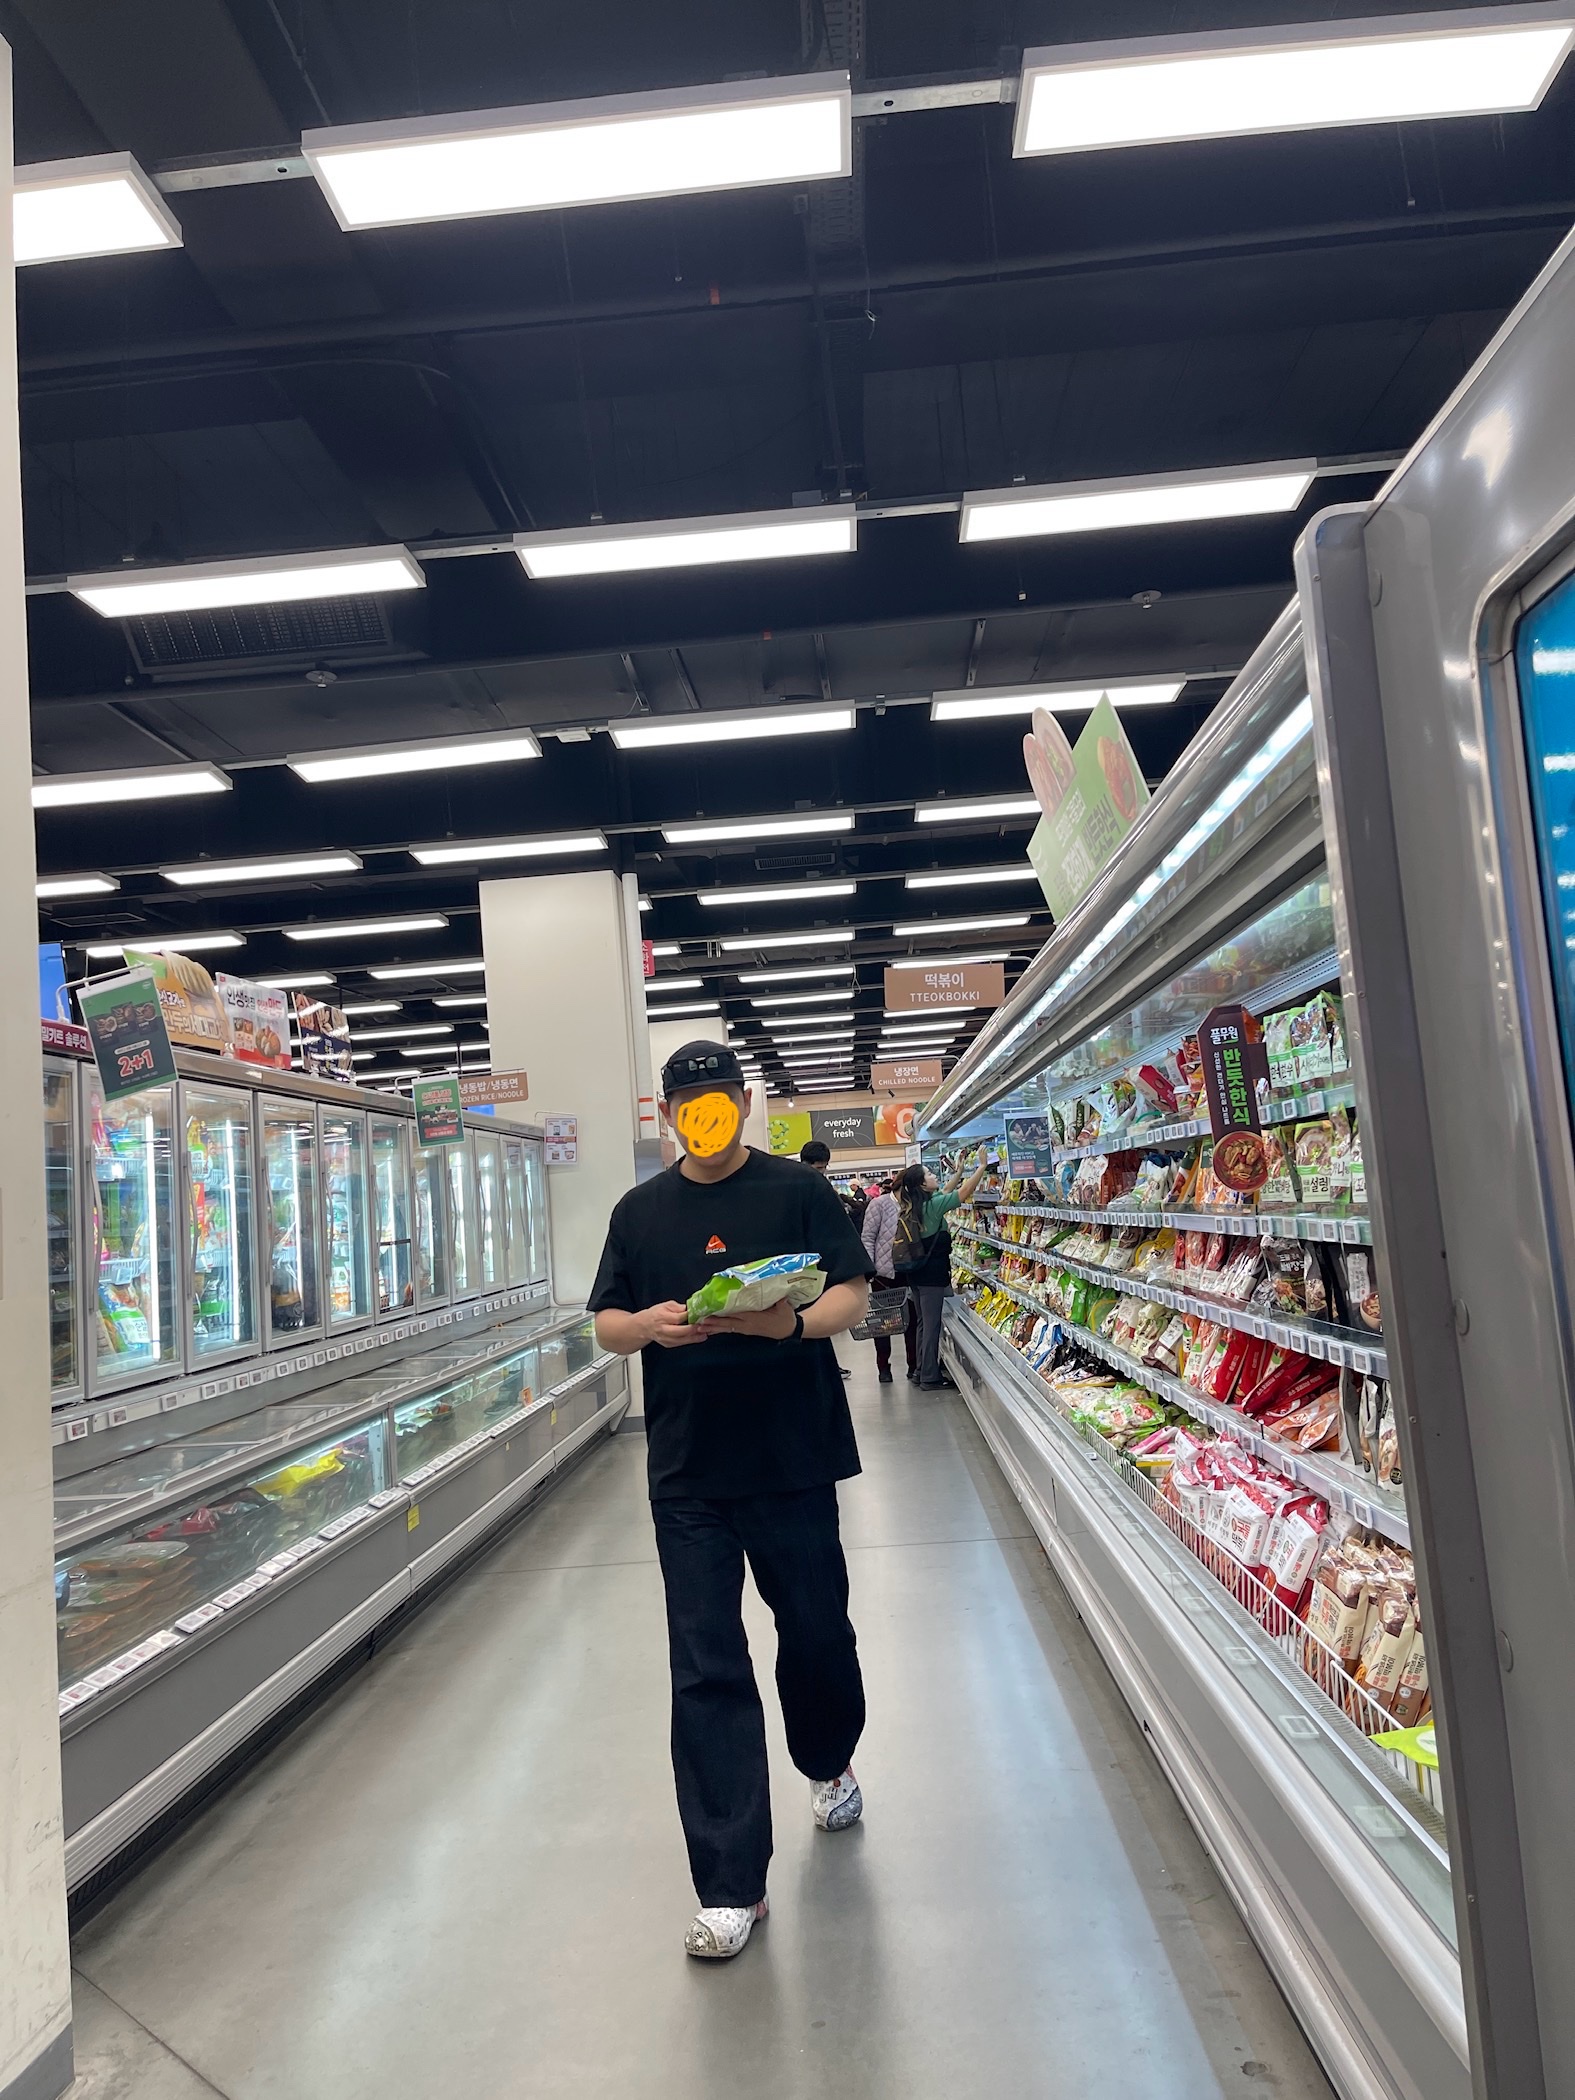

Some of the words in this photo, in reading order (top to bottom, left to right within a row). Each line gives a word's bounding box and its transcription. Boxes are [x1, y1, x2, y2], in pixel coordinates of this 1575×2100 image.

[924, 972, 964, 988] 떡볶이
[910, 991, 980, 1003] TTEOKBOKKI
[41, 1026, 64, 1044] 밀키트
[65, 1031, 88, 1049] 솔루션
[1209, 1026, 1239, 1045] 풀무원
[117, 1049, 155, 1077] 2+1
[894, 1066, 919, 1077] 냉장면
[878, 1078, 906, 1086] CHILLED
[908, 1076, 936, 1084] NOODLE
[1222, 1048, 1252, 1126] 반듯한식
[459, 1094, 480, 1104] ROZEN
[480, 1089, 524, 1101] RICE/NOODLE
[824, 1117, 862, 1131] everyday
[832, 1128, 855, 1139] fresh
